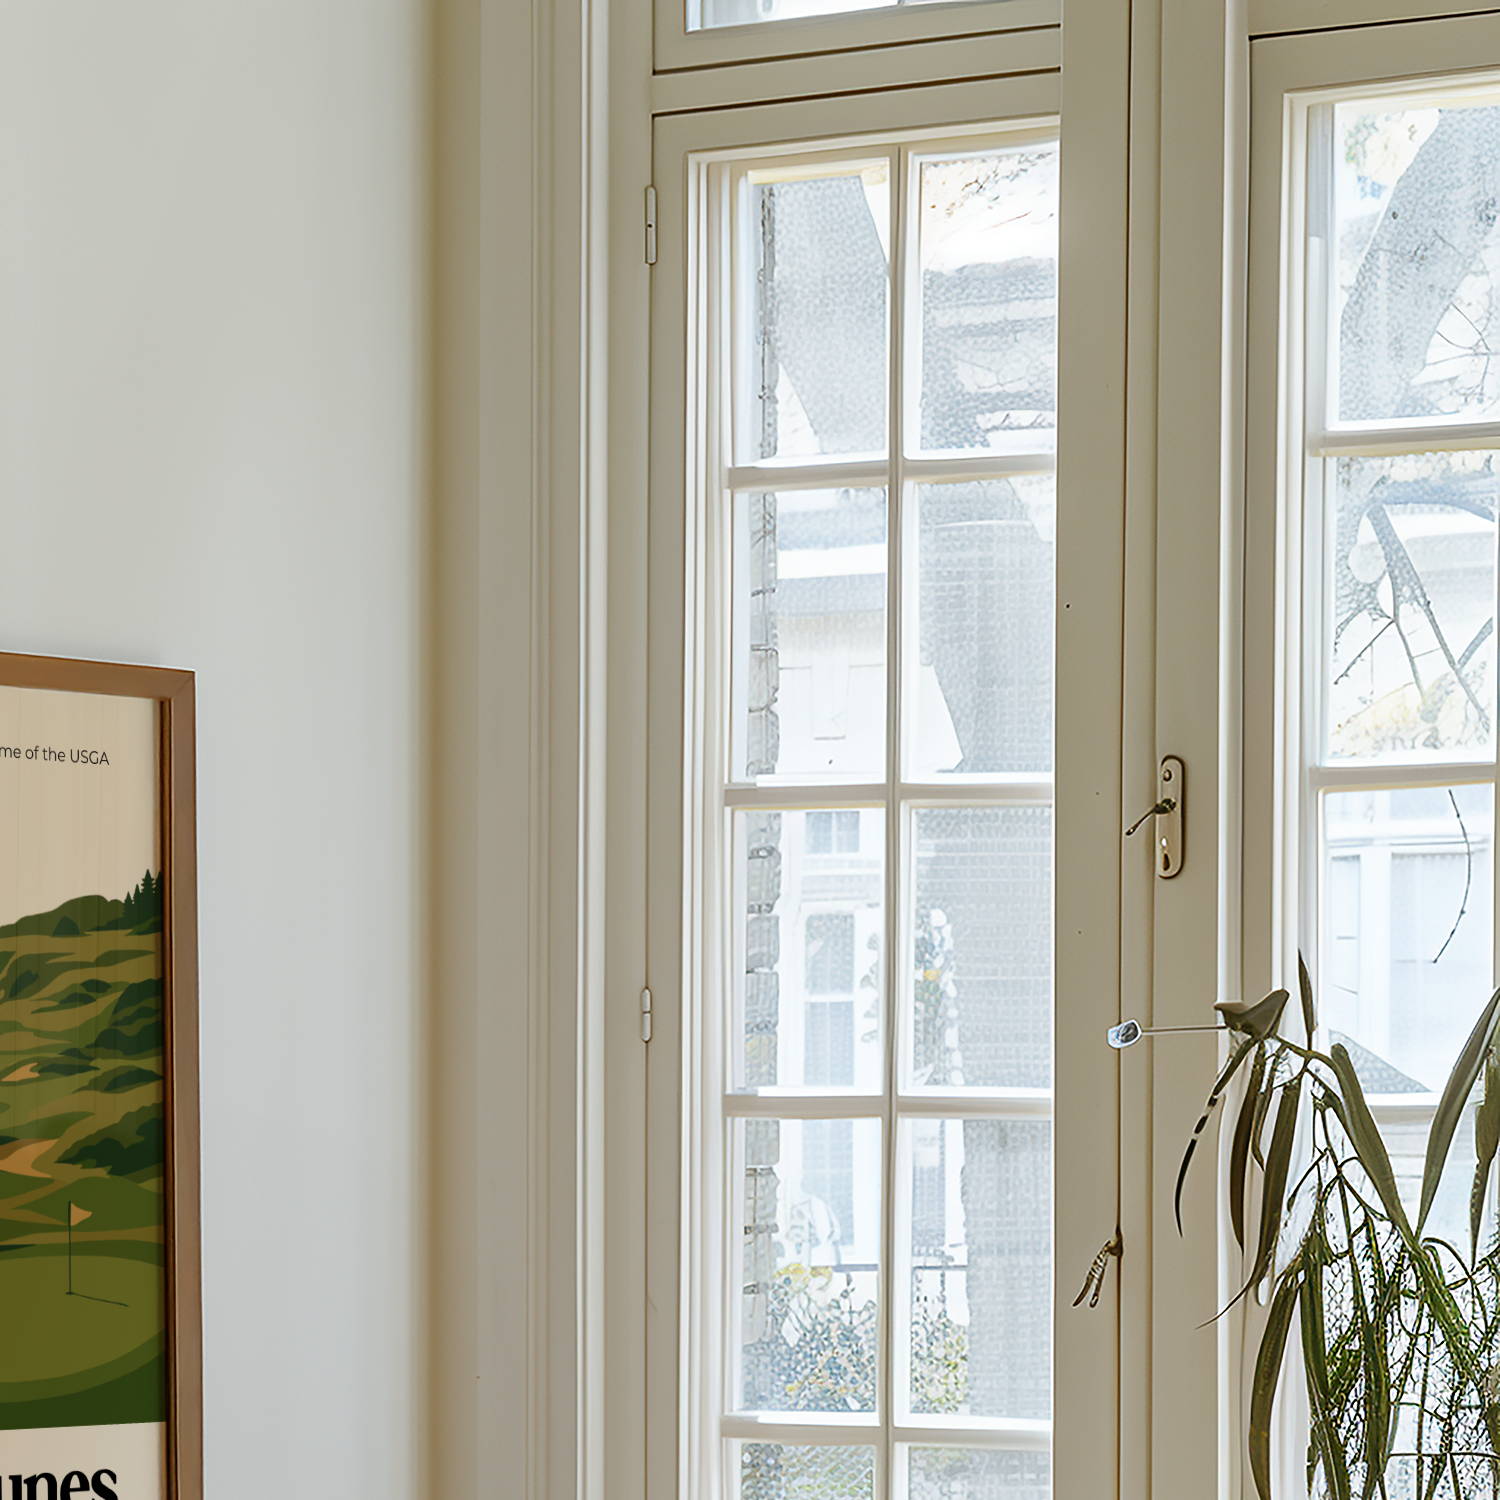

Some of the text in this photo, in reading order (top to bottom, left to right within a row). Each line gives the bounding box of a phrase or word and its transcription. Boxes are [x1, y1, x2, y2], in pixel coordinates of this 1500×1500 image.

[25, 745, 40, 760] of
[41, 746, 66, 763] the
[70, 748, 110, 766] USGA
